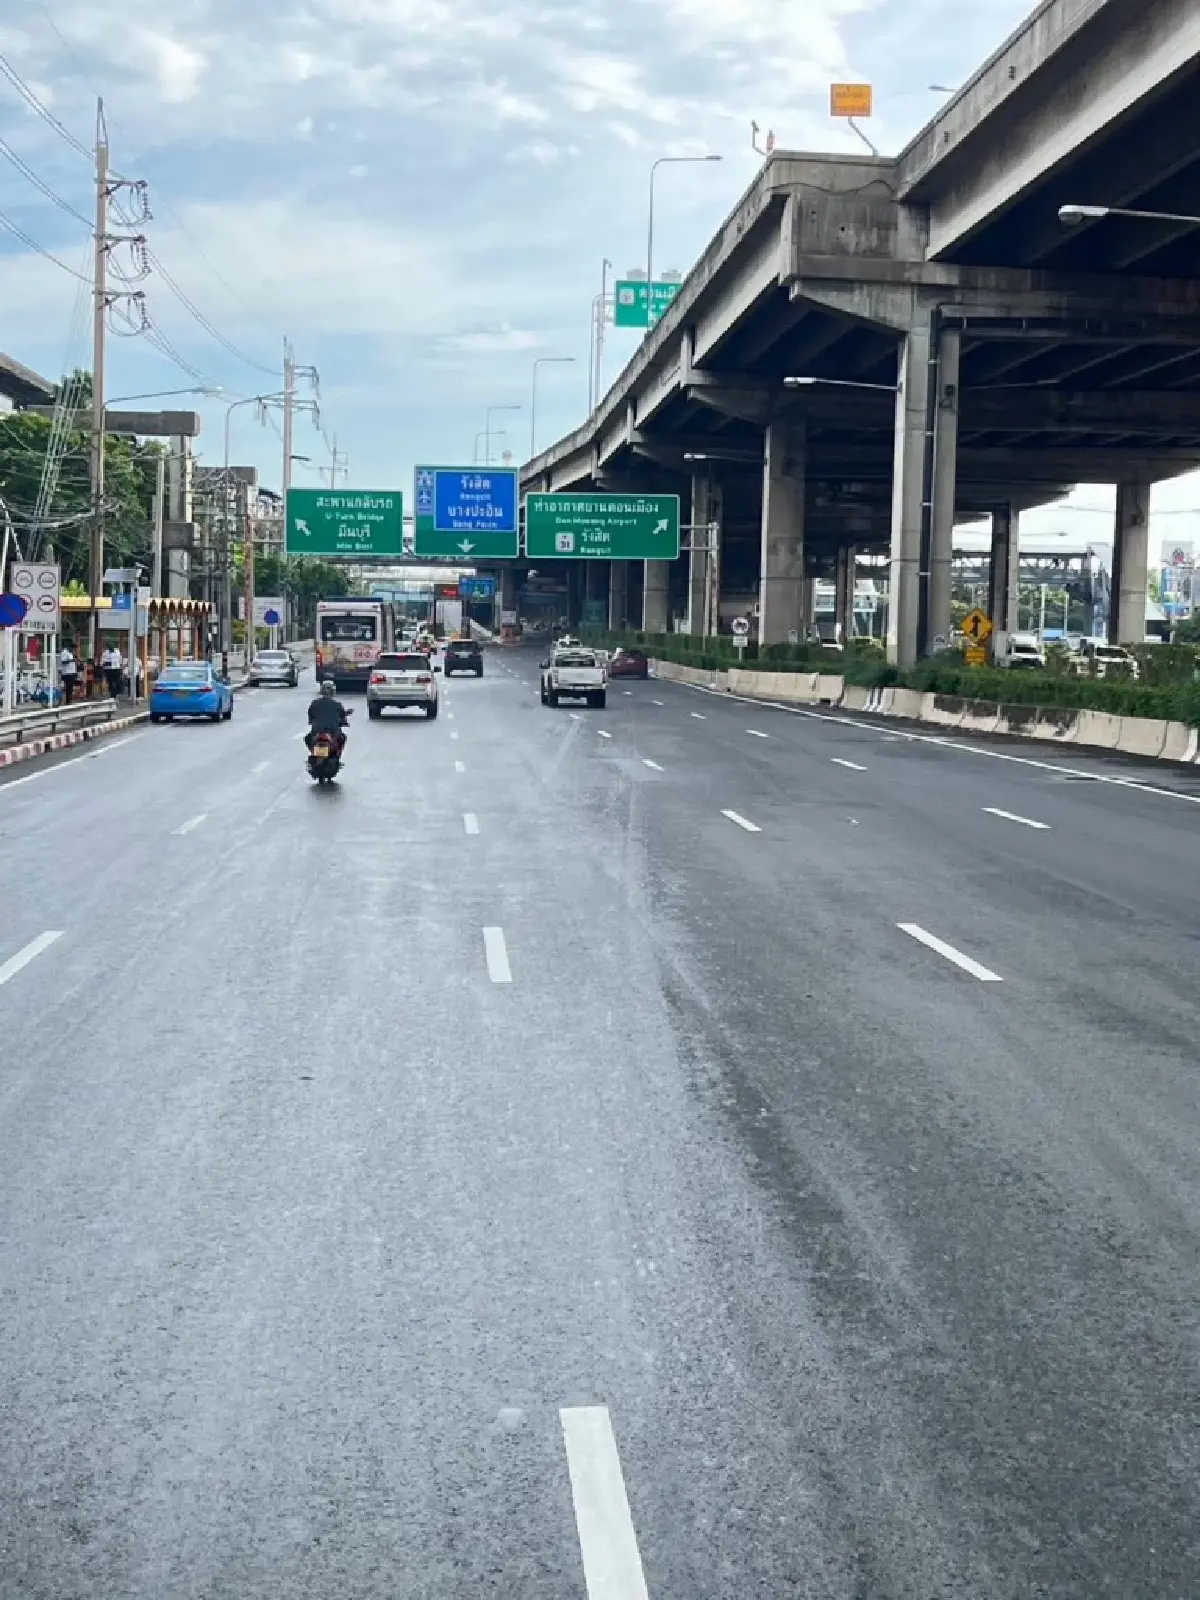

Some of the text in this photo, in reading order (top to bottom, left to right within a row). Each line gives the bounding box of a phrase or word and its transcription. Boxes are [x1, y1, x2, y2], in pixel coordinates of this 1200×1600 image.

[461, 474, 492, 490] รังสิต
[316, 494, 394, 509] สะพานกลับรถ
[533, 498, 659, 513] ท่าอากาศยานดอนเมือง
[357, 512, 384, 522] Bridge
[447, 502, 503, 517] บางปะอิน
[607, 516, 637, 527] Airport
[338, 523, 371, 542] มีนบุรี
[581, 527, 610, 542] รังสิต
